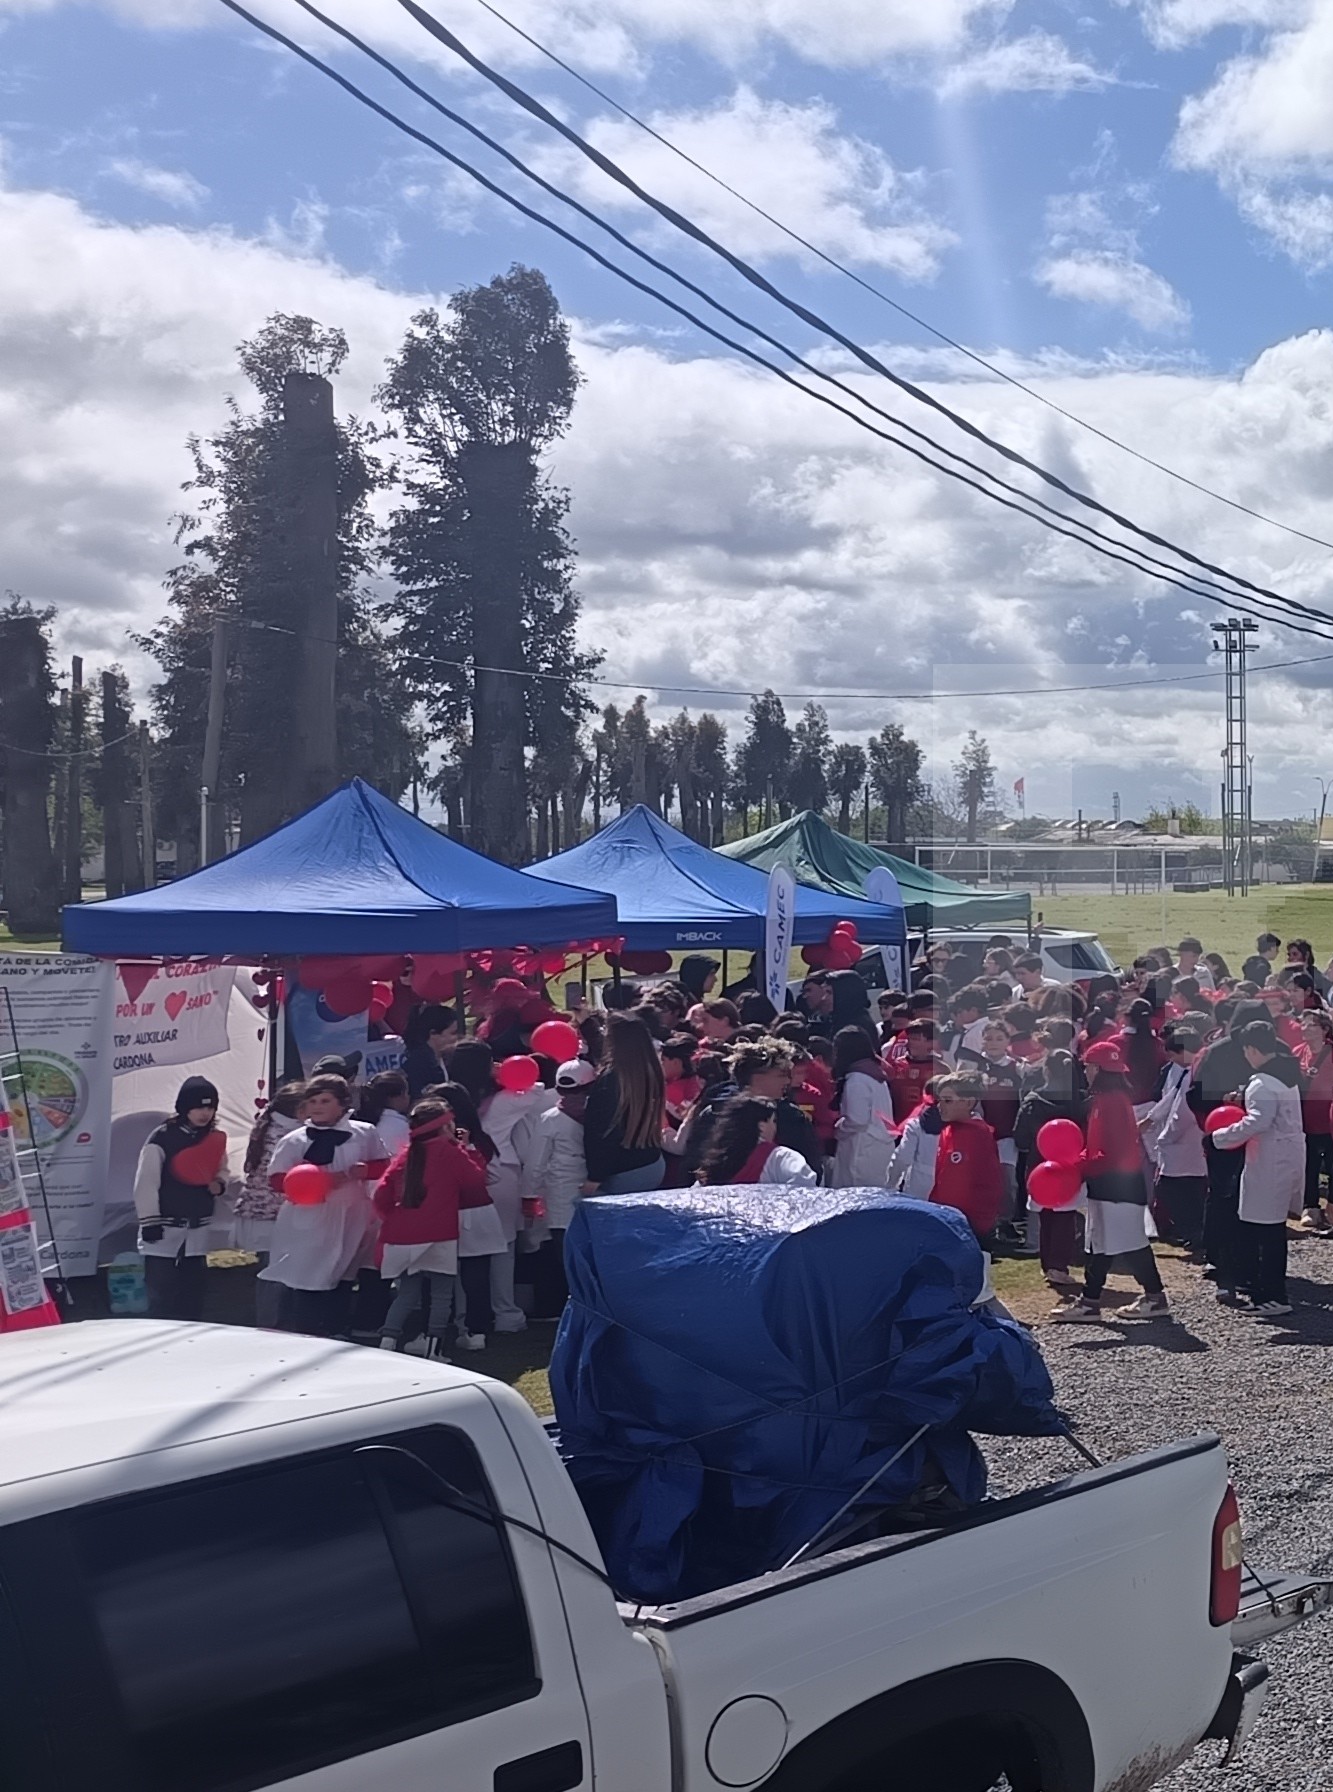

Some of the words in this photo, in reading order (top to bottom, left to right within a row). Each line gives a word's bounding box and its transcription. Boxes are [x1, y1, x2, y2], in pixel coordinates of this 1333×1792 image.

[774, 884, 786, 964] CAMEC
[35, 958, 51, 966] LA
[115, 1003, 138, 1018] POR
[133, 1029, 178, 1045] AUXILIAR
[113, 1052, 156, 1070] CARDONA
